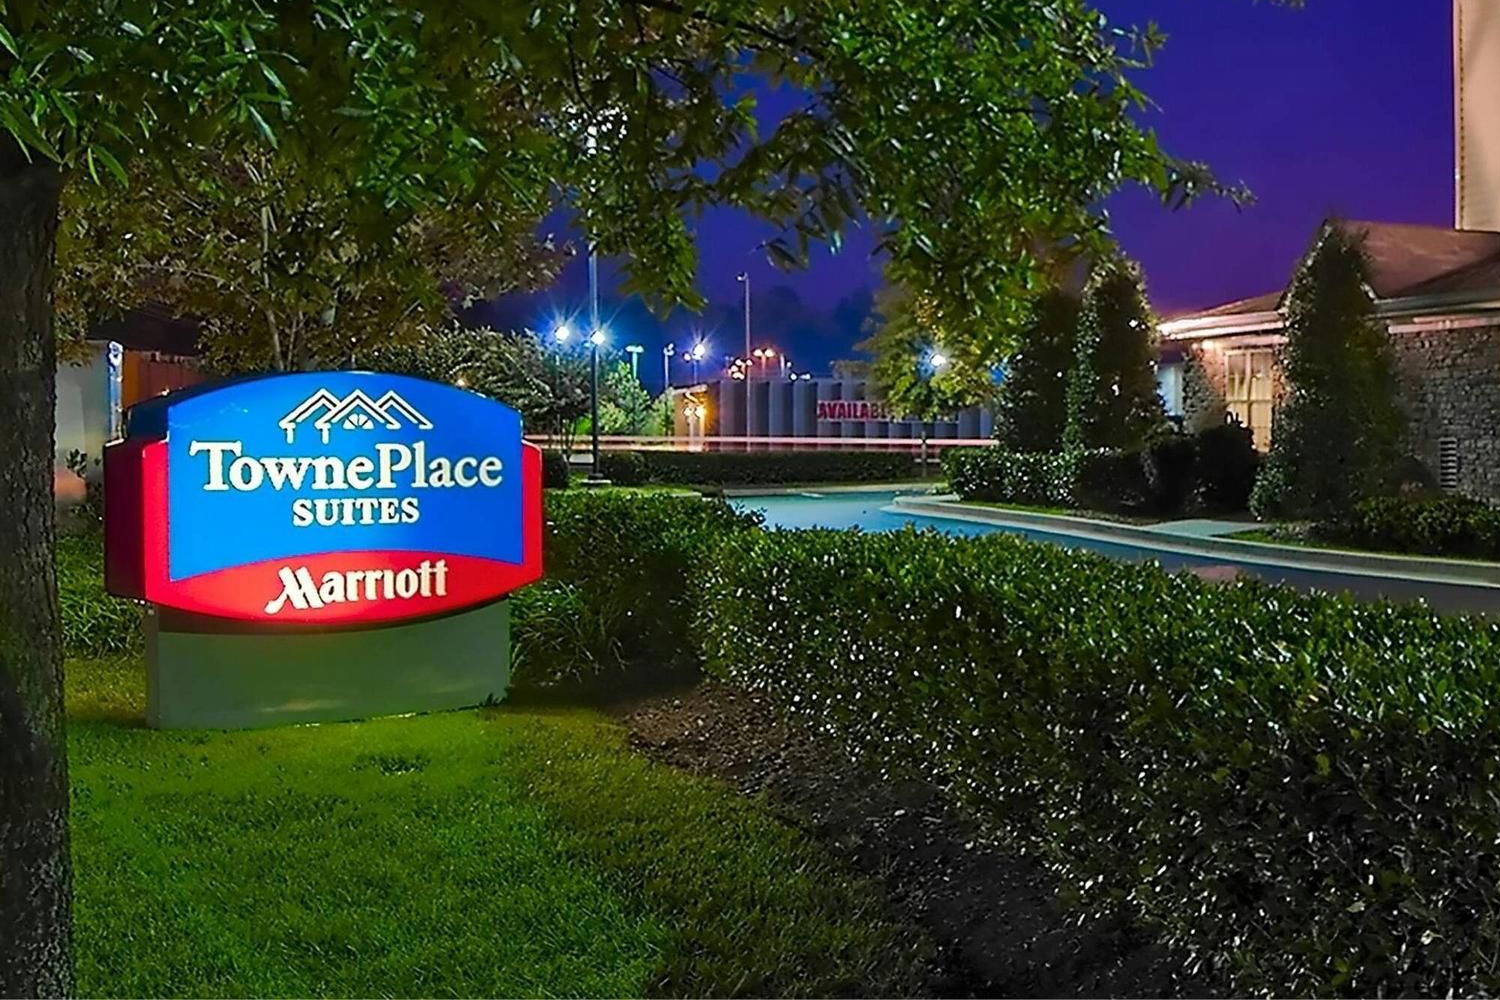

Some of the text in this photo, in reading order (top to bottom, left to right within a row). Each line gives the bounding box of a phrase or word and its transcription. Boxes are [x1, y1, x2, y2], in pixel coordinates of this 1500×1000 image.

[189, 439, 503, 491] TownePlace
[292, 497, 420, 527] SUITES
[263, 559, 449, 615] Marriott
